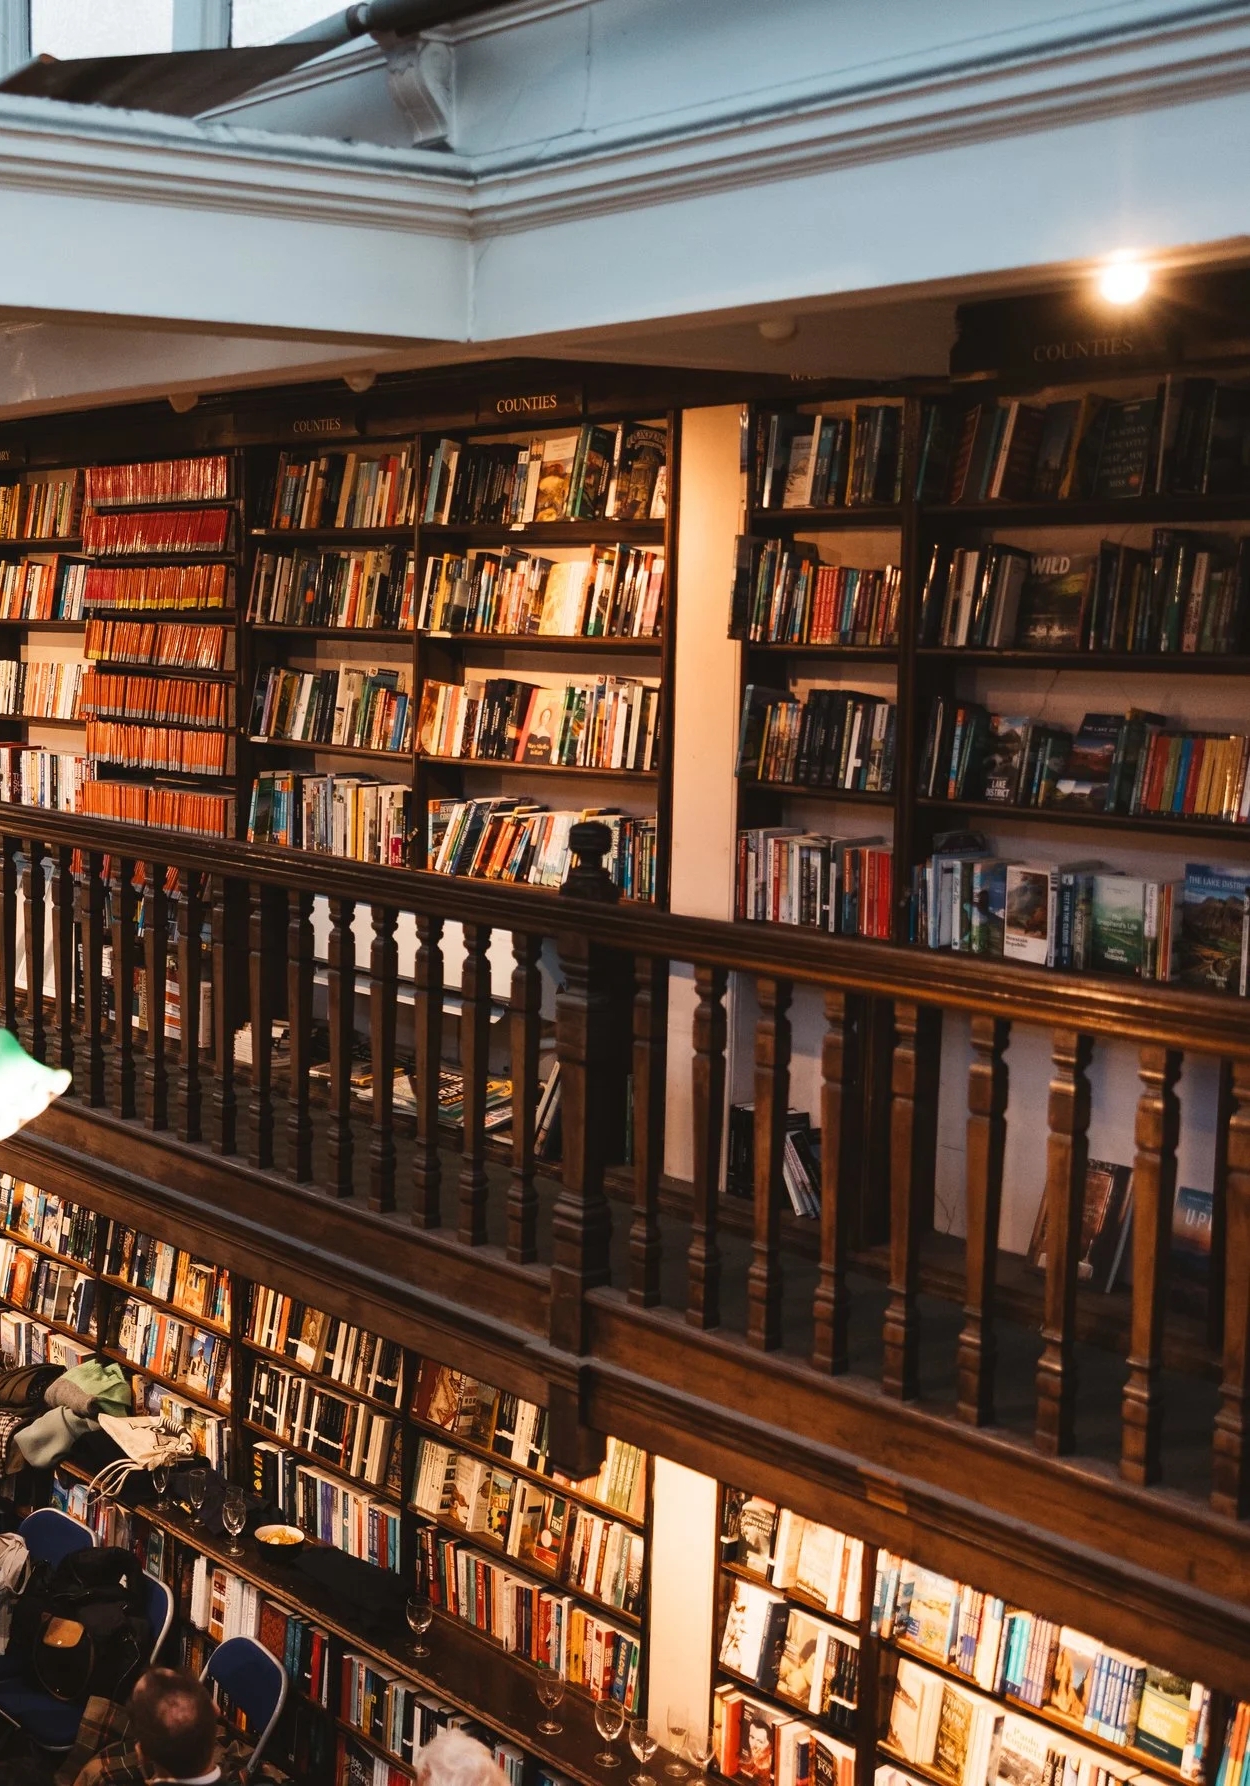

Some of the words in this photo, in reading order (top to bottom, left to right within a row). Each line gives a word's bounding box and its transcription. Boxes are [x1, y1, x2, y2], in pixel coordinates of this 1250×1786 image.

[1033, 338, 1133, 363] COUNTIES
[496, 394, 557, 414] COUNTIES
[293, 417, 341, 433] COUNTIES
[1031, 555, 1070, 575] WILD
[985, 788, 1010, 798] DISTRICT
[992, 780, 1007, 789] LAKE
[1188, 876, 1201, 885] THE
[1203, 877, 1220, 887] LAKE
[1062, 911, 1070, 922] THE
[1062, 922, 1070, 944] CLOUDS
[1128, 923, 1139, 931] Life
[213, 1361, 225, 1391] Eastern
[617, 1569, 625, 1590] POWER
[632, 1583, 639, 1594] OF
[796, 1581, 811, 1593] CHARLES
[617, 1641, 627, 1676] CALCIO
[1005, 1731, 1042, 1760] Cognetti
[1014, 1726, 1039, 1748] Paolo
[817, 1759, 832, 1779] FOX
